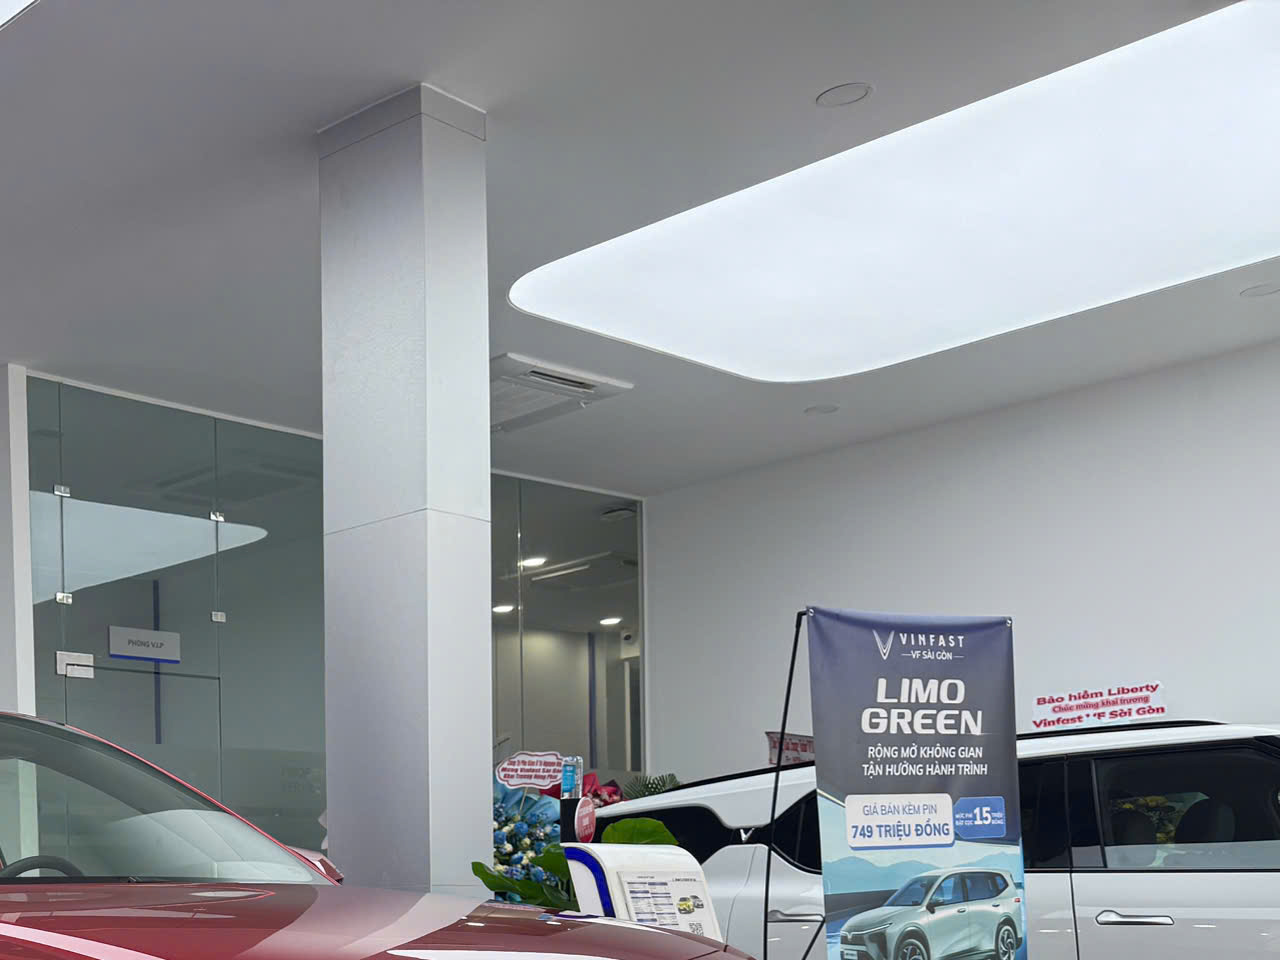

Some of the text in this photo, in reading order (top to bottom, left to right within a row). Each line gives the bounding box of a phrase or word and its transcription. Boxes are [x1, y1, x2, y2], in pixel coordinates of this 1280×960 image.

[899, 633, 965, 647] VINFAST
[876, 677, 965, 704] LIMO
[861, 707, 983, 735] GREEN
[868, 743, 898, 761] RỘNG
[920, 743, 955, 759] KHÔNG
[958, 746, 983, 759] GIAN
[862, 761, 883, 779] TẬN
[926, 760, 955, 776] HÀNH
[957, 760, 988, 776] TRÌNH
[862, 803, 879, 816] GIÁ
[880, 803, 900, 816] BÁN
[922, 803, 937, 815] PIN
[973, 806, 992, 825] 15
[851, 824, 873, 839] 749
[876, 820, 911, 841] TRIỆU
